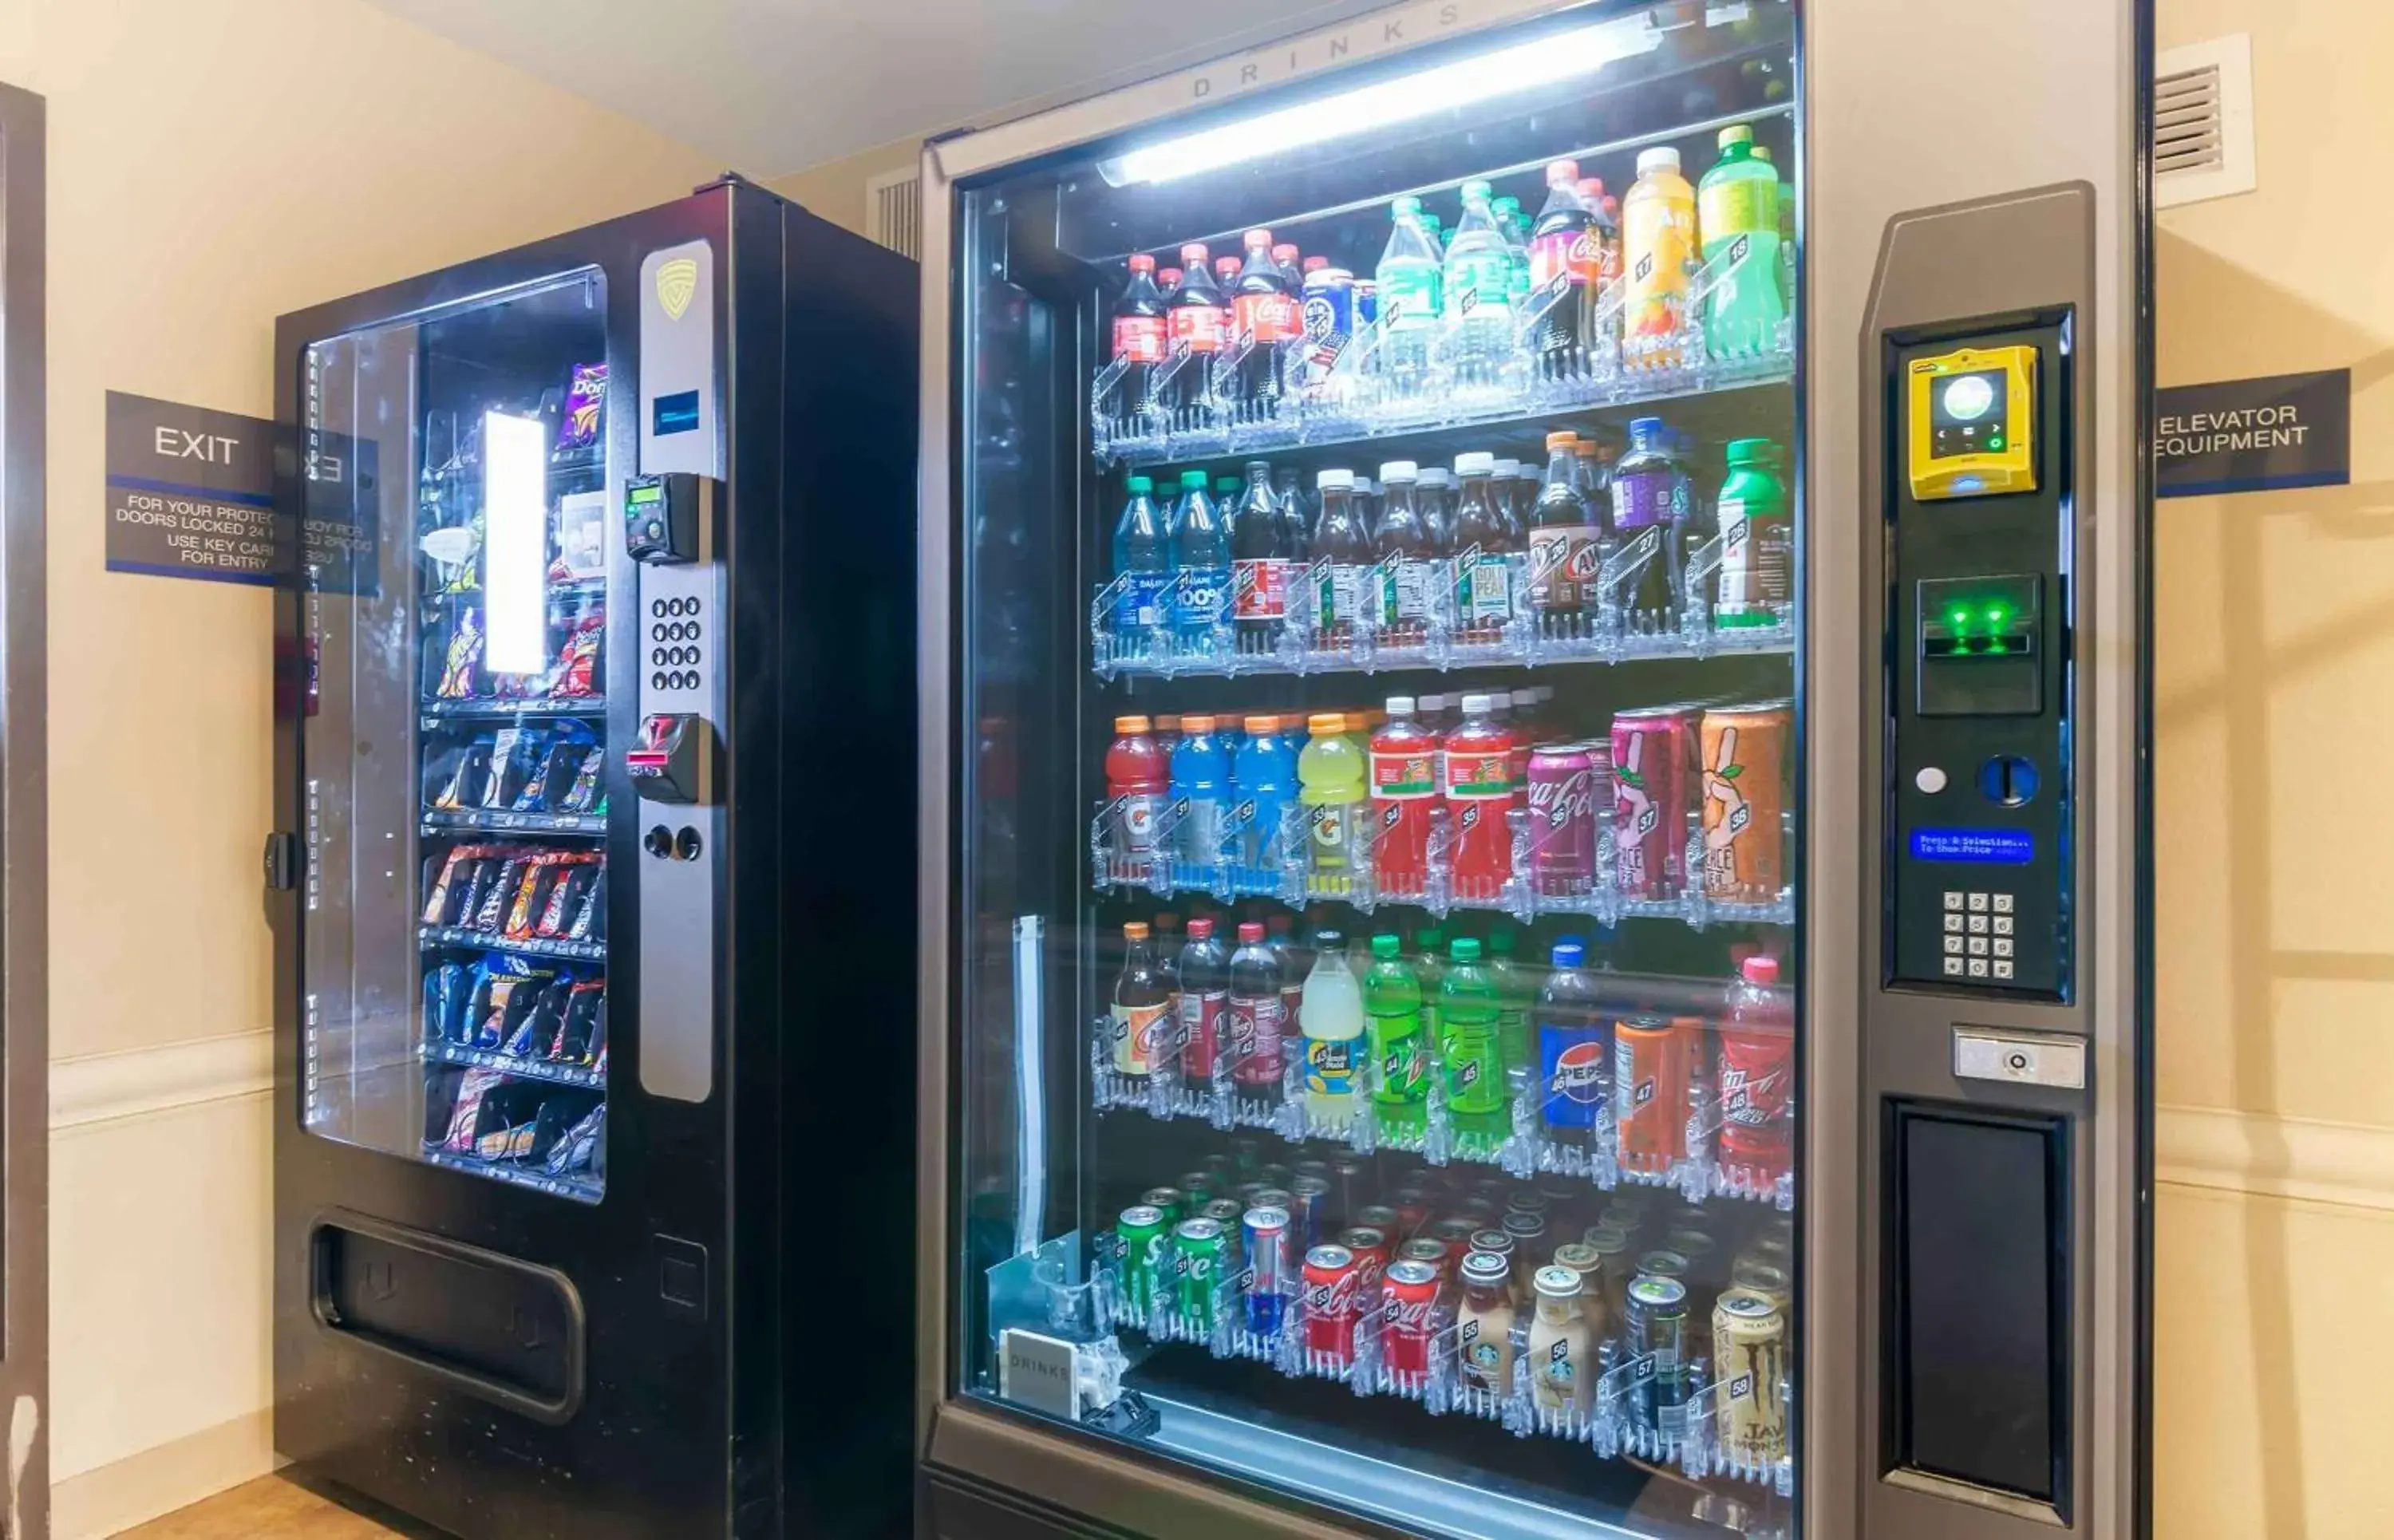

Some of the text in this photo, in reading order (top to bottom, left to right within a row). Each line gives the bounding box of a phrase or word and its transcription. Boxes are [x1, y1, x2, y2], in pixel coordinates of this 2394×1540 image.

[1194, 3, 1459, 97] DRINKS
[2159, 405, 2297, 435] ELEVATOR
[156, 426, 239, 464] EXIT
[2155, 426, 2309, 457] EQUIPMENT
[128, 495, 162, 511] FOR
[168, 500, 211, 518] YOUR
[116, 509, 176, 527] DOORS
[182, 517, 244, 535] LOCKED
[249, 527, 265, 538] 24
[168, 534, 200, 549] USE
[205, 538, 235, 552] KEY
[181, 550, 268, 569] FOR ENTRY
[1011, 1355, 1068, 1380] DRINKS
[1638, 1360, 1653, 1376] 57
[1733, 1378, 1748, 1396] 58
